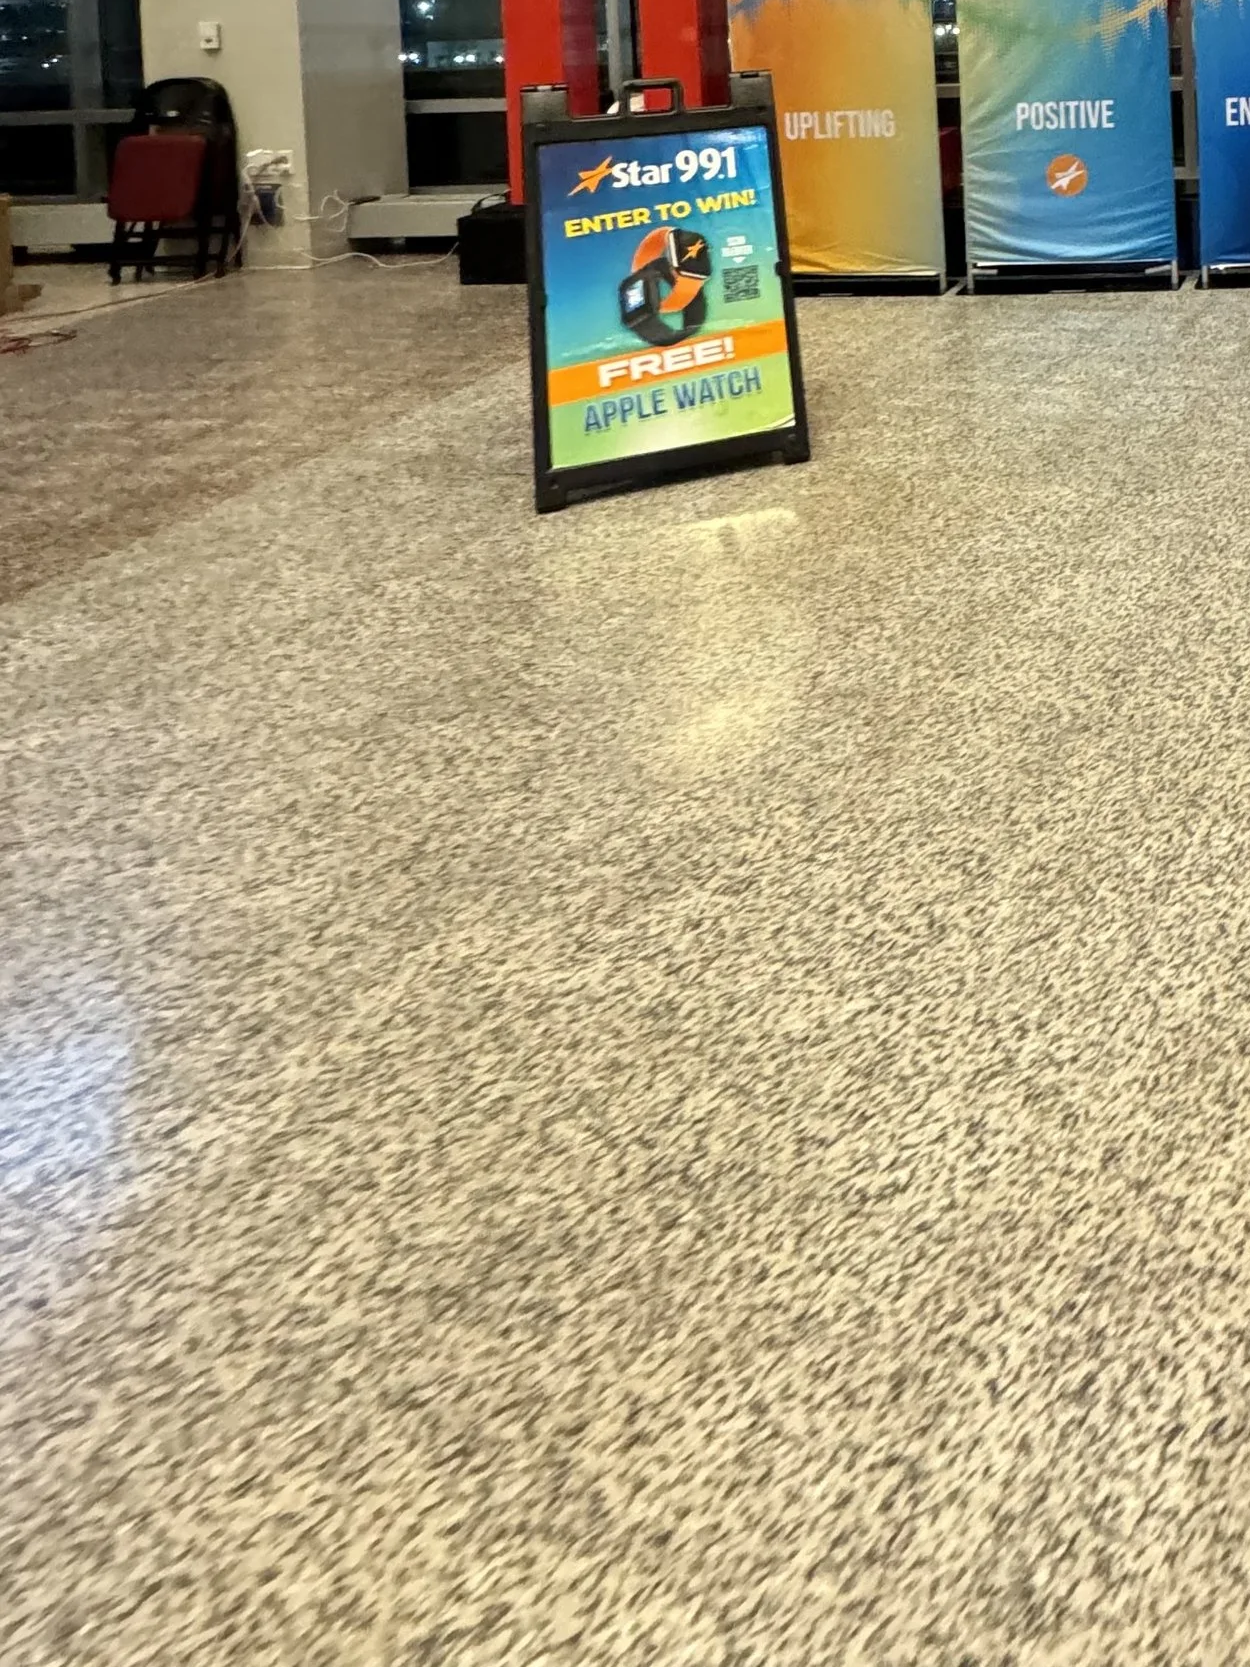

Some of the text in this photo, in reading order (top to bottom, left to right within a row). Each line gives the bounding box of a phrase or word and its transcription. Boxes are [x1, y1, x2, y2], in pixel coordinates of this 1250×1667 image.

[784, 109, 896, 141] UPLIFTING
[1014, 99, 1115, 132] POSITIVE
[611, 146, 738, 188] Star 99.1
[564, 189, 758, 239] ENTER TO WIN!
[597, 336, 737, 389] FREE!
[583, 364, 762, 434] APPLE WATCH
